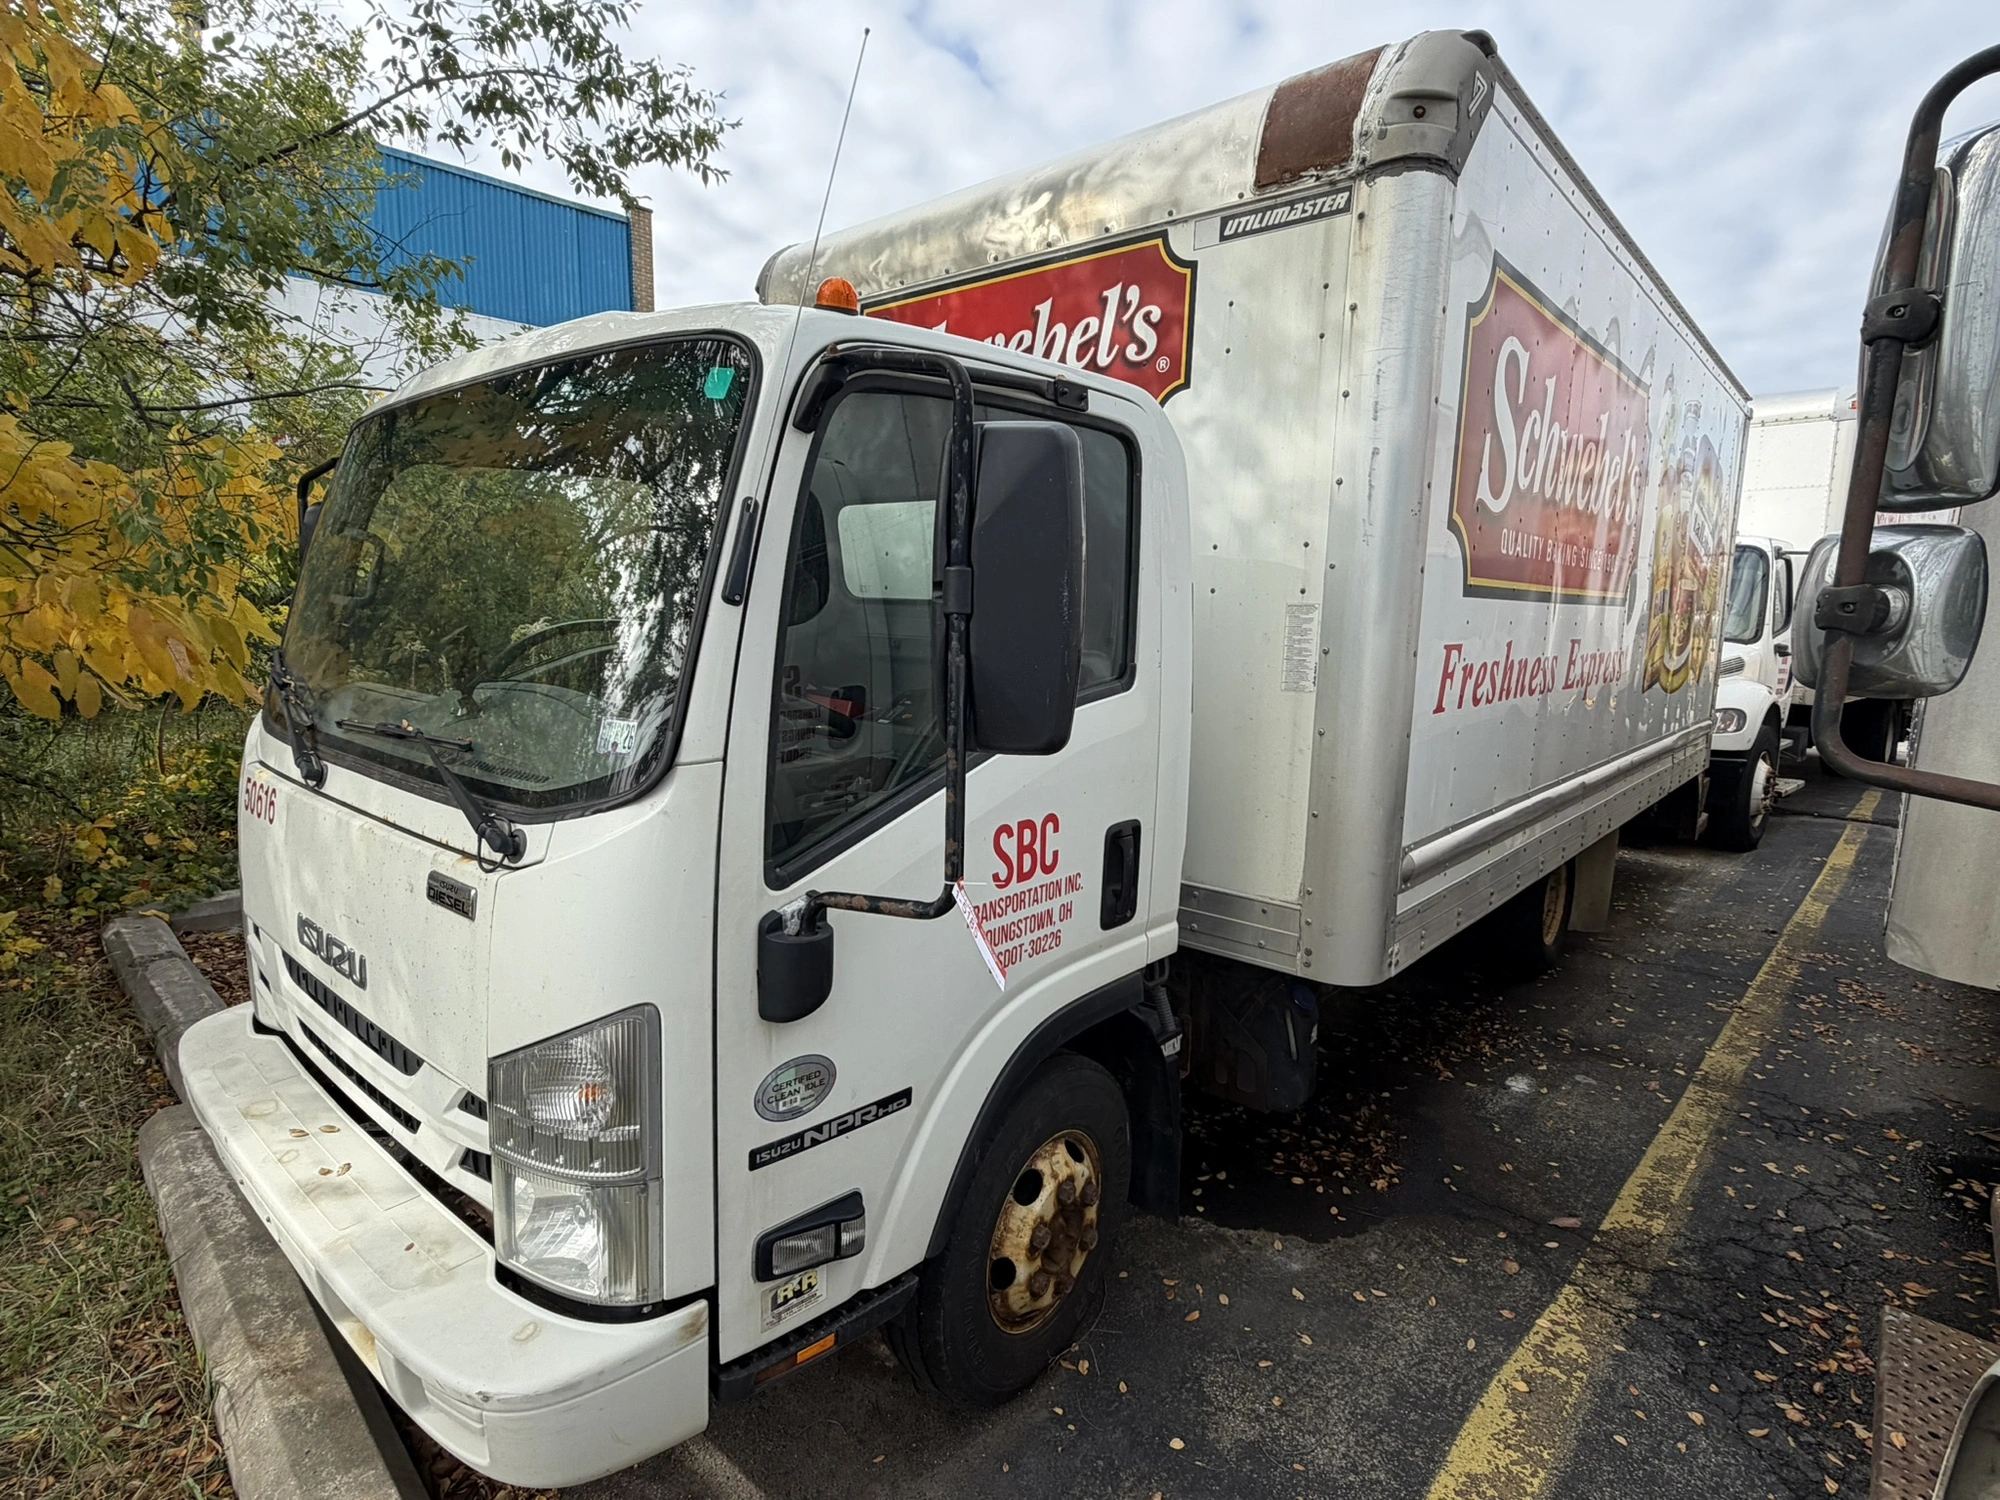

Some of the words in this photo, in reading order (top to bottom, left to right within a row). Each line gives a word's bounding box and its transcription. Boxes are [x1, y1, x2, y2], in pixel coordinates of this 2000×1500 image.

[1475, 335, 1640, 526] Schwebel's
[1500, 528, 1544, 560] QUALITY
[1546, 539, 1578, 567] BAKING
[1431, 639, 1558, 715] Freshness
[1562, 638, 1624, 700] Express
[244, 776, 278, 825] 50616
[992, 813, 1060, 889] SBC
[428, 886, 470, 917] DIESEL
[973, 878, 1062, 925] RANSPORTATION
[1064, 872, 1084, 897] INC.
[985, 908, 1056, 948] OUNGSTOWN,
[1059, 900, 1073, 923] OH
[297, 911, 367, 991] ISUZU
[997, 929, 1062, 970] SDOT-30226
[767, 1087, 801, 1105] CLEAN
[804, 1078, 826, 1092] IDLE
[772, 1070, 821, 1093] CERTIFIED
[756, 1138, 801, 1164] ISUZU
[803, 1104, 877, 1148] NPR
[878, 1098, 907, 1117] HD
